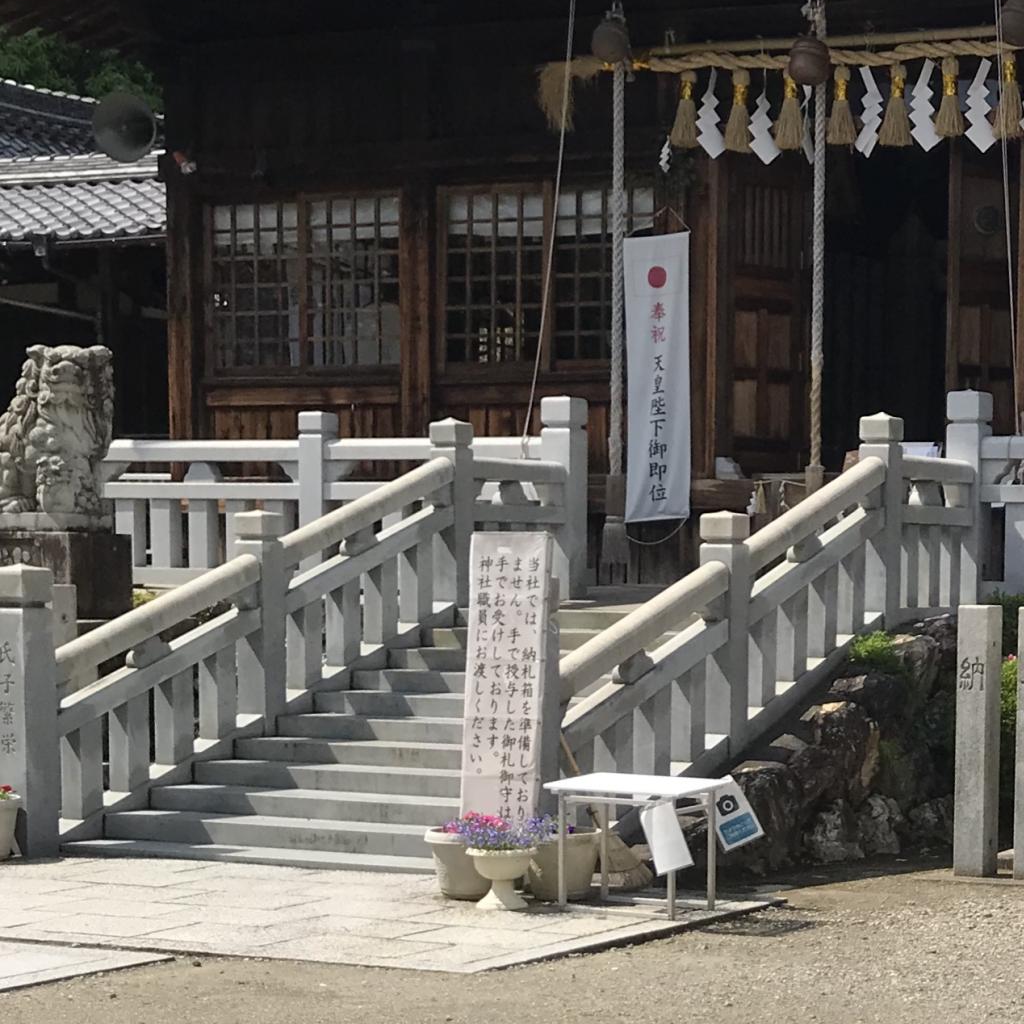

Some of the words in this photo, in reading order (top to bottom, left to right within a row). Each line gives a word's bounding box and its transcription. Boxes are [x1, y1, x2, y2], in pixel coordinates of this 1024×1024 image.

[650, 301, 667, 344] 奉祝
[648, 355, 668, 503] 天皇陛下御即位
[470, 556, 494, 775] 神社職員にお渡しください。
[486, 556, 509, 758] 手でお受けしております。
[498, 557, 524, 819] ません。手で授与した御札御守は
[516, 556, 541, 823] 当社では、納札箱を準備しており
[959, 656, 985, 691] 納
